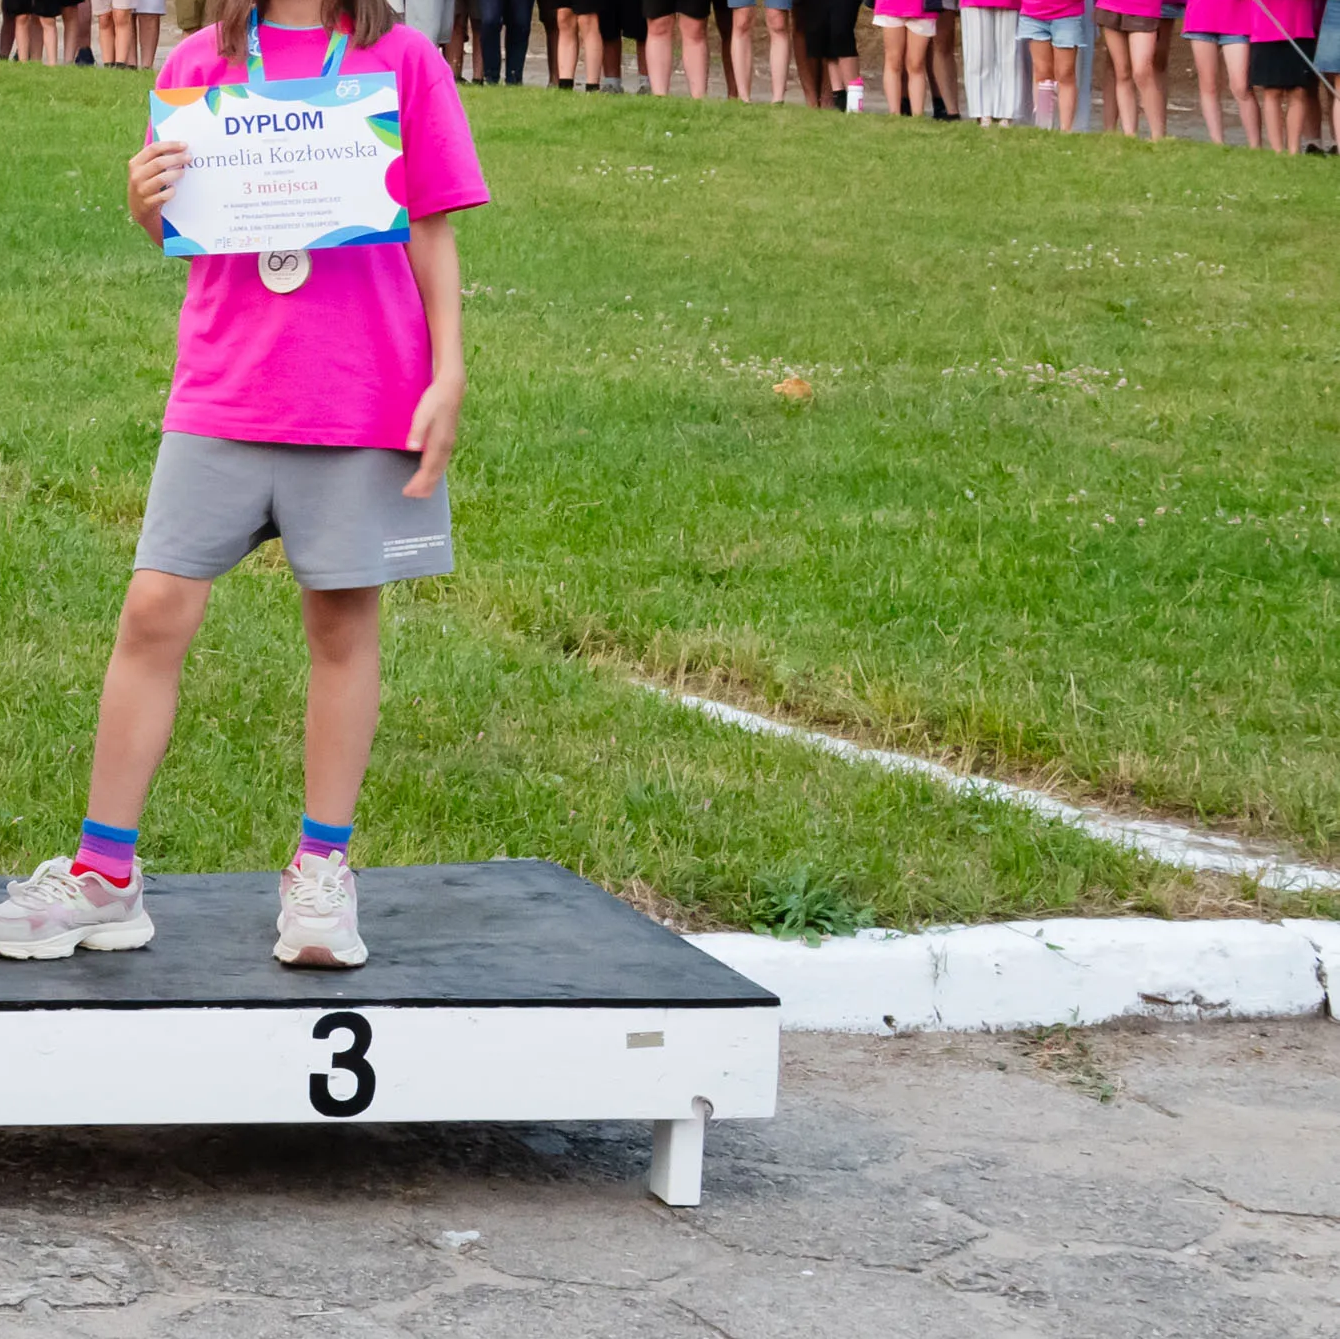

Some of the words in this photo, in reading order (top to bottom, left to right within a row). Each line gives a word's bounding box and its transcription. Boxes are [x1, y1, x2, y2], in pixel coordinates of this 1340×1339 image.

[224, 110, 324, 136] DYPLOM
[269, 140, 378, 165] Kozłowska
[243, 181, 252, 195] 3
[257, 179, 318, 196] miejsca
[309, 1011, 376, 1117] 3
